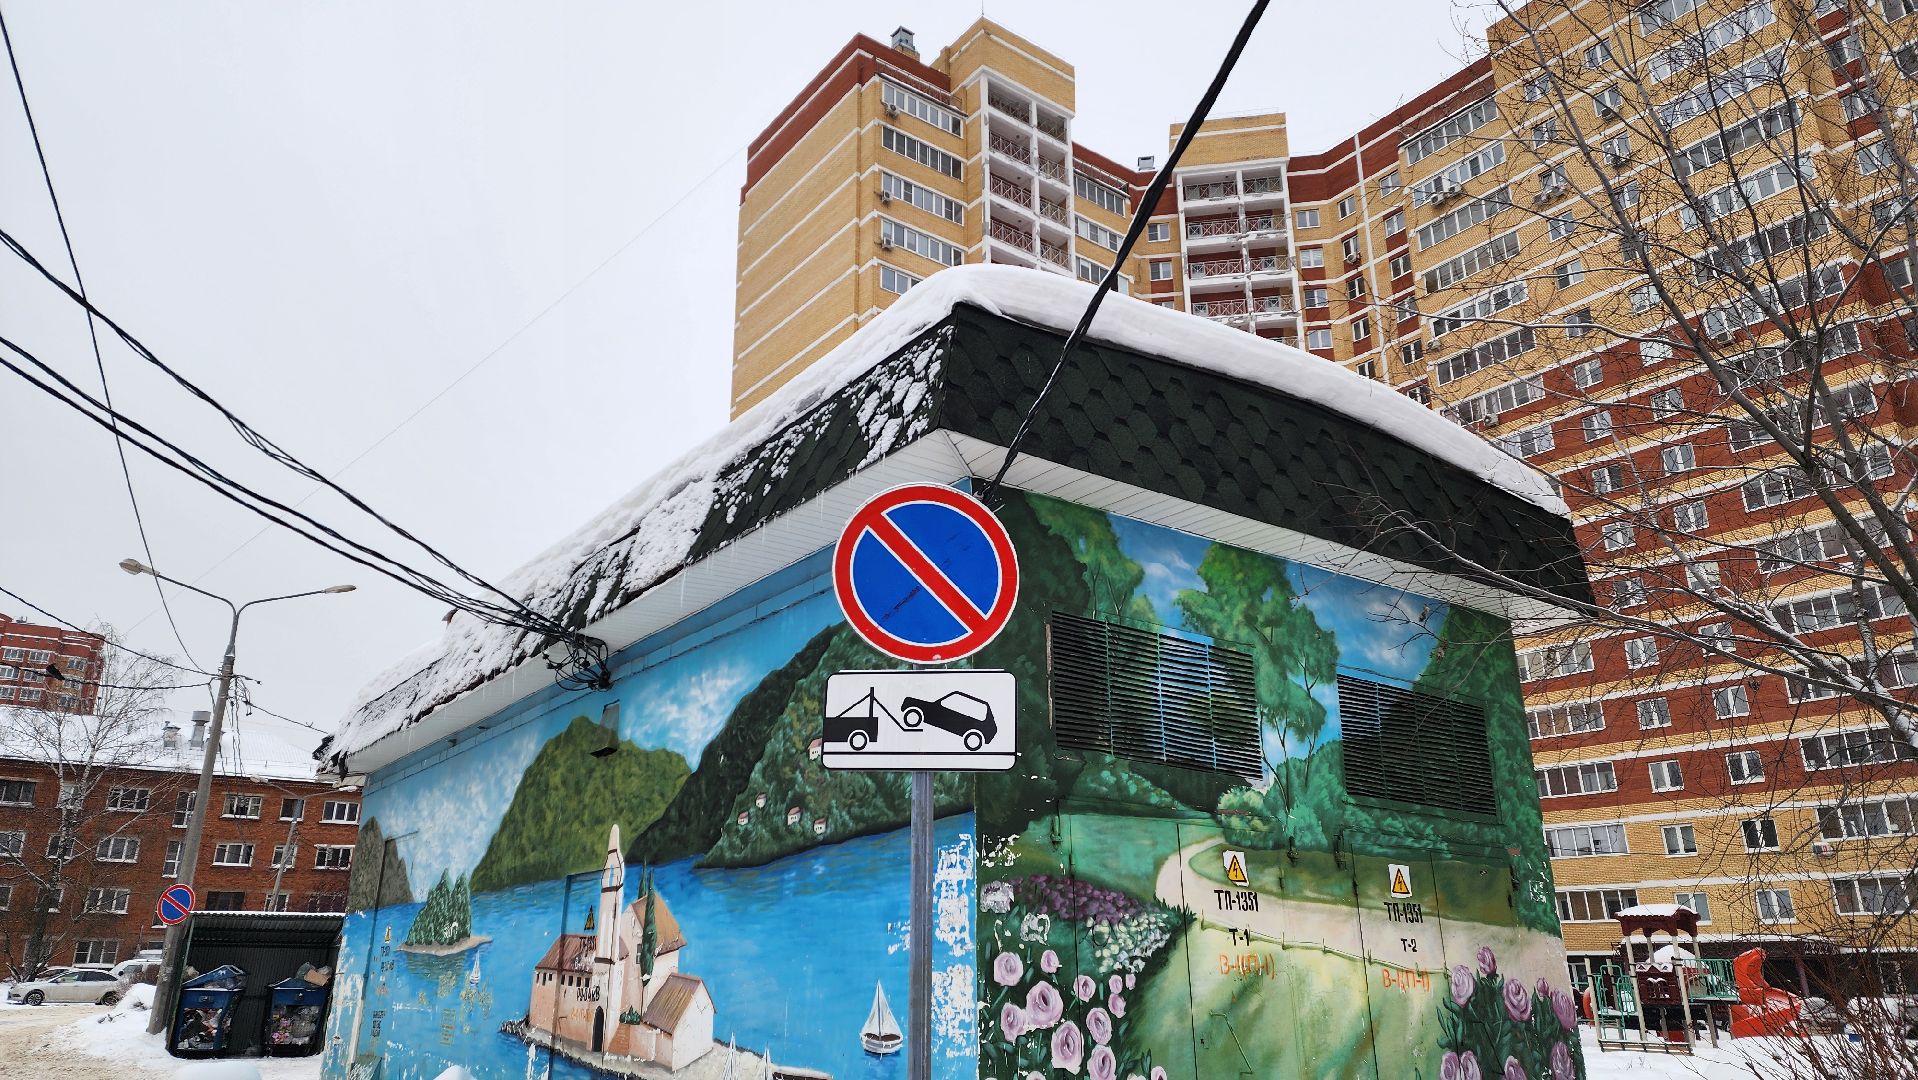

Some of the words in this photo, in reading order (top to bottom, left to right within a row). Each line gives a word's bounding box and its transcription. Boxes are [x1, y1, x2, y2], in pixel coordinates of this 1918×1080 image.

[1213, 889, 1259, 912] ТП-1351
[1383, 902, 1424, 923] ТП-1351
[1228, 927, 1250, 947] Т-1
[1400, 938, 1418, 953] Т-2
